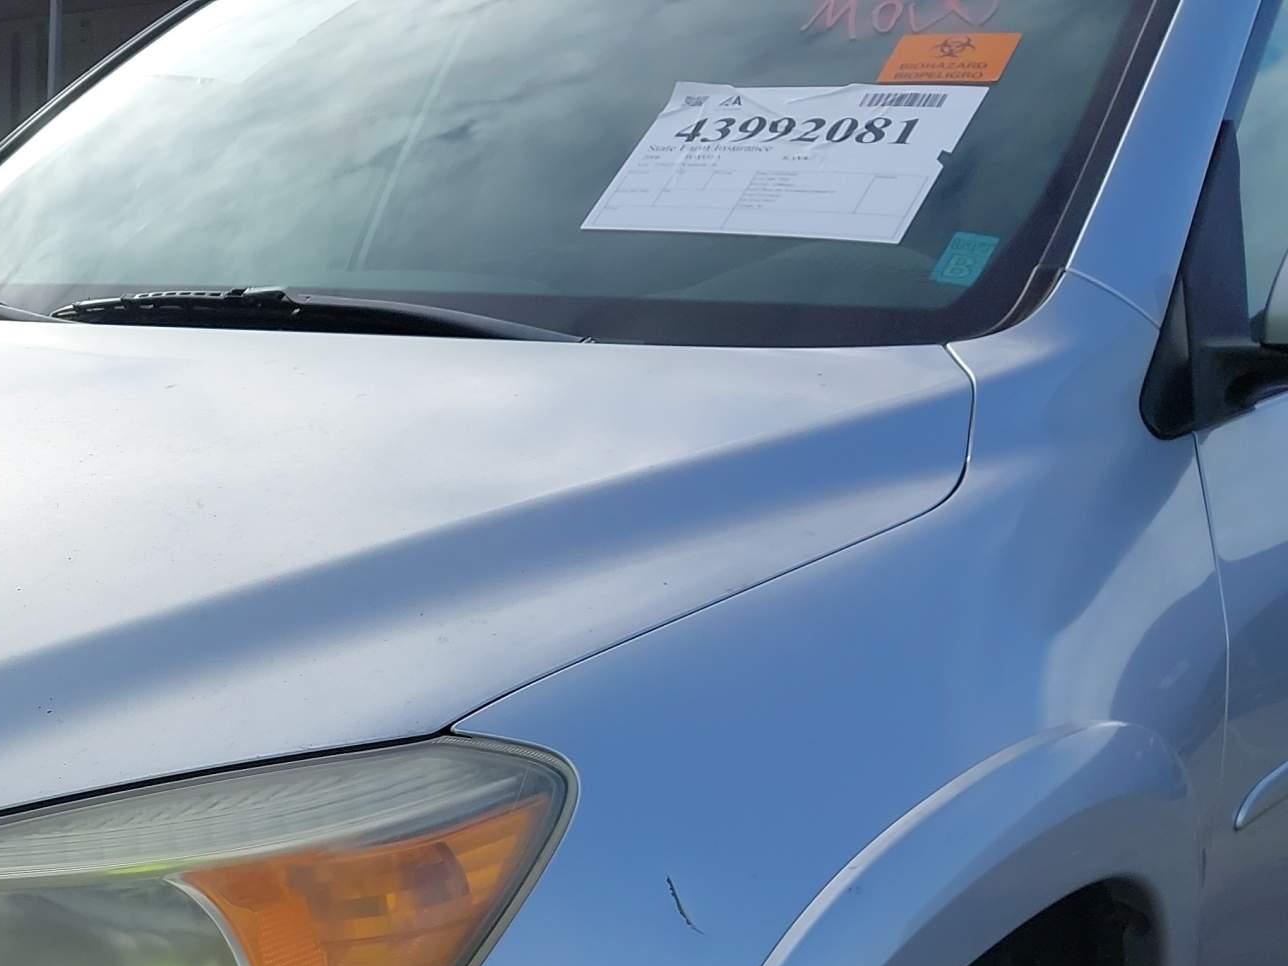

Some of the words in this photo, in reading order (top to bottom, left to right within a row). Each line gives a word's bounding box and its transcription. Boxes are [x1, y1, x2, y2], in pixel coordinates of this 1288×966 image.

[899, 62, 988, 70] BIOHAZARD
[893, 71, 984, 79] BIOPELIGRO
[674, 116, 920, 144] 43992081
